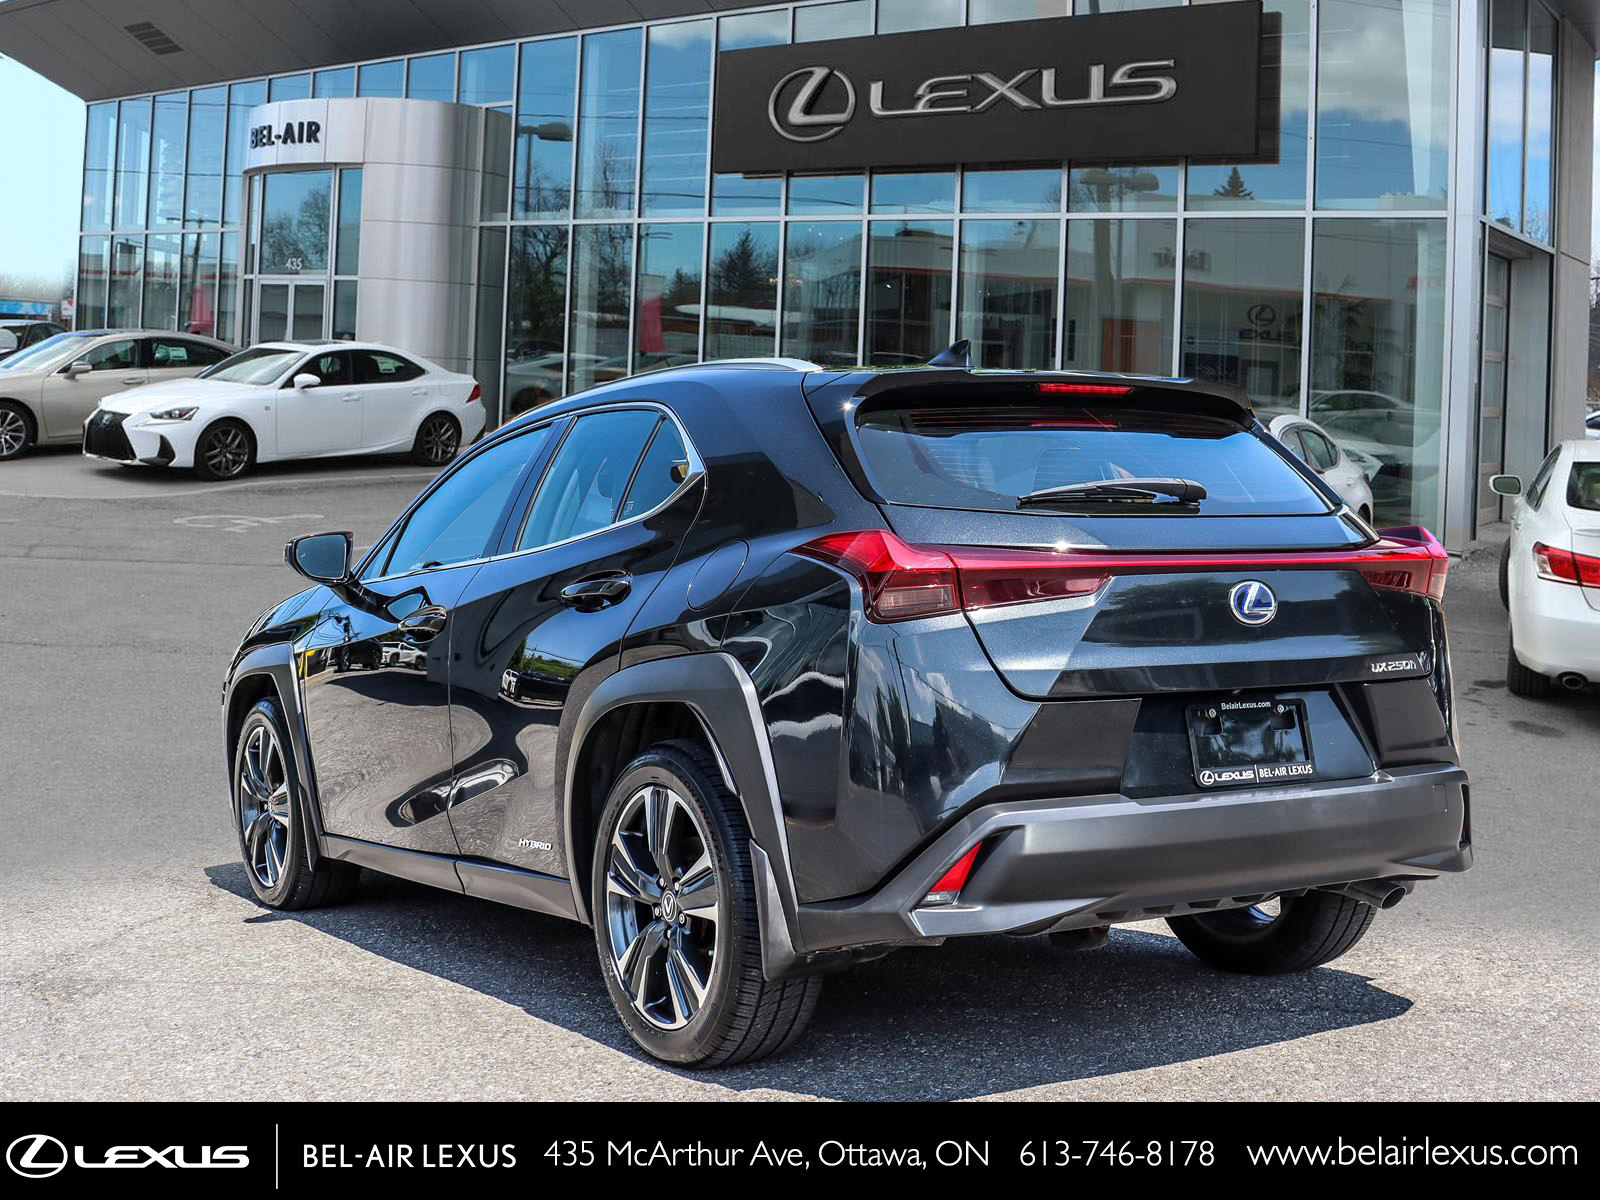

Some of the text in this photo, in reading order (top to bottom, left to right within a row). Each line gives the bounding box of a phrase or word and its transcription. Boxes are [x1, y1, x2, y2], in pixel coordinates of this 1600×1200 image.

[868, 59, 1177, 118] LEXUS
[250, 121, 321, 149] BEL-AIR
[286, 257, 302, 270] 435
[1221, 701, 1271, 711] BelairLexus.com
[1215, 770, 1254, 781] LEXUS
[1288, 764, 1313, 776] LEXUS
[519, 838, 552, 851] HYBRID
